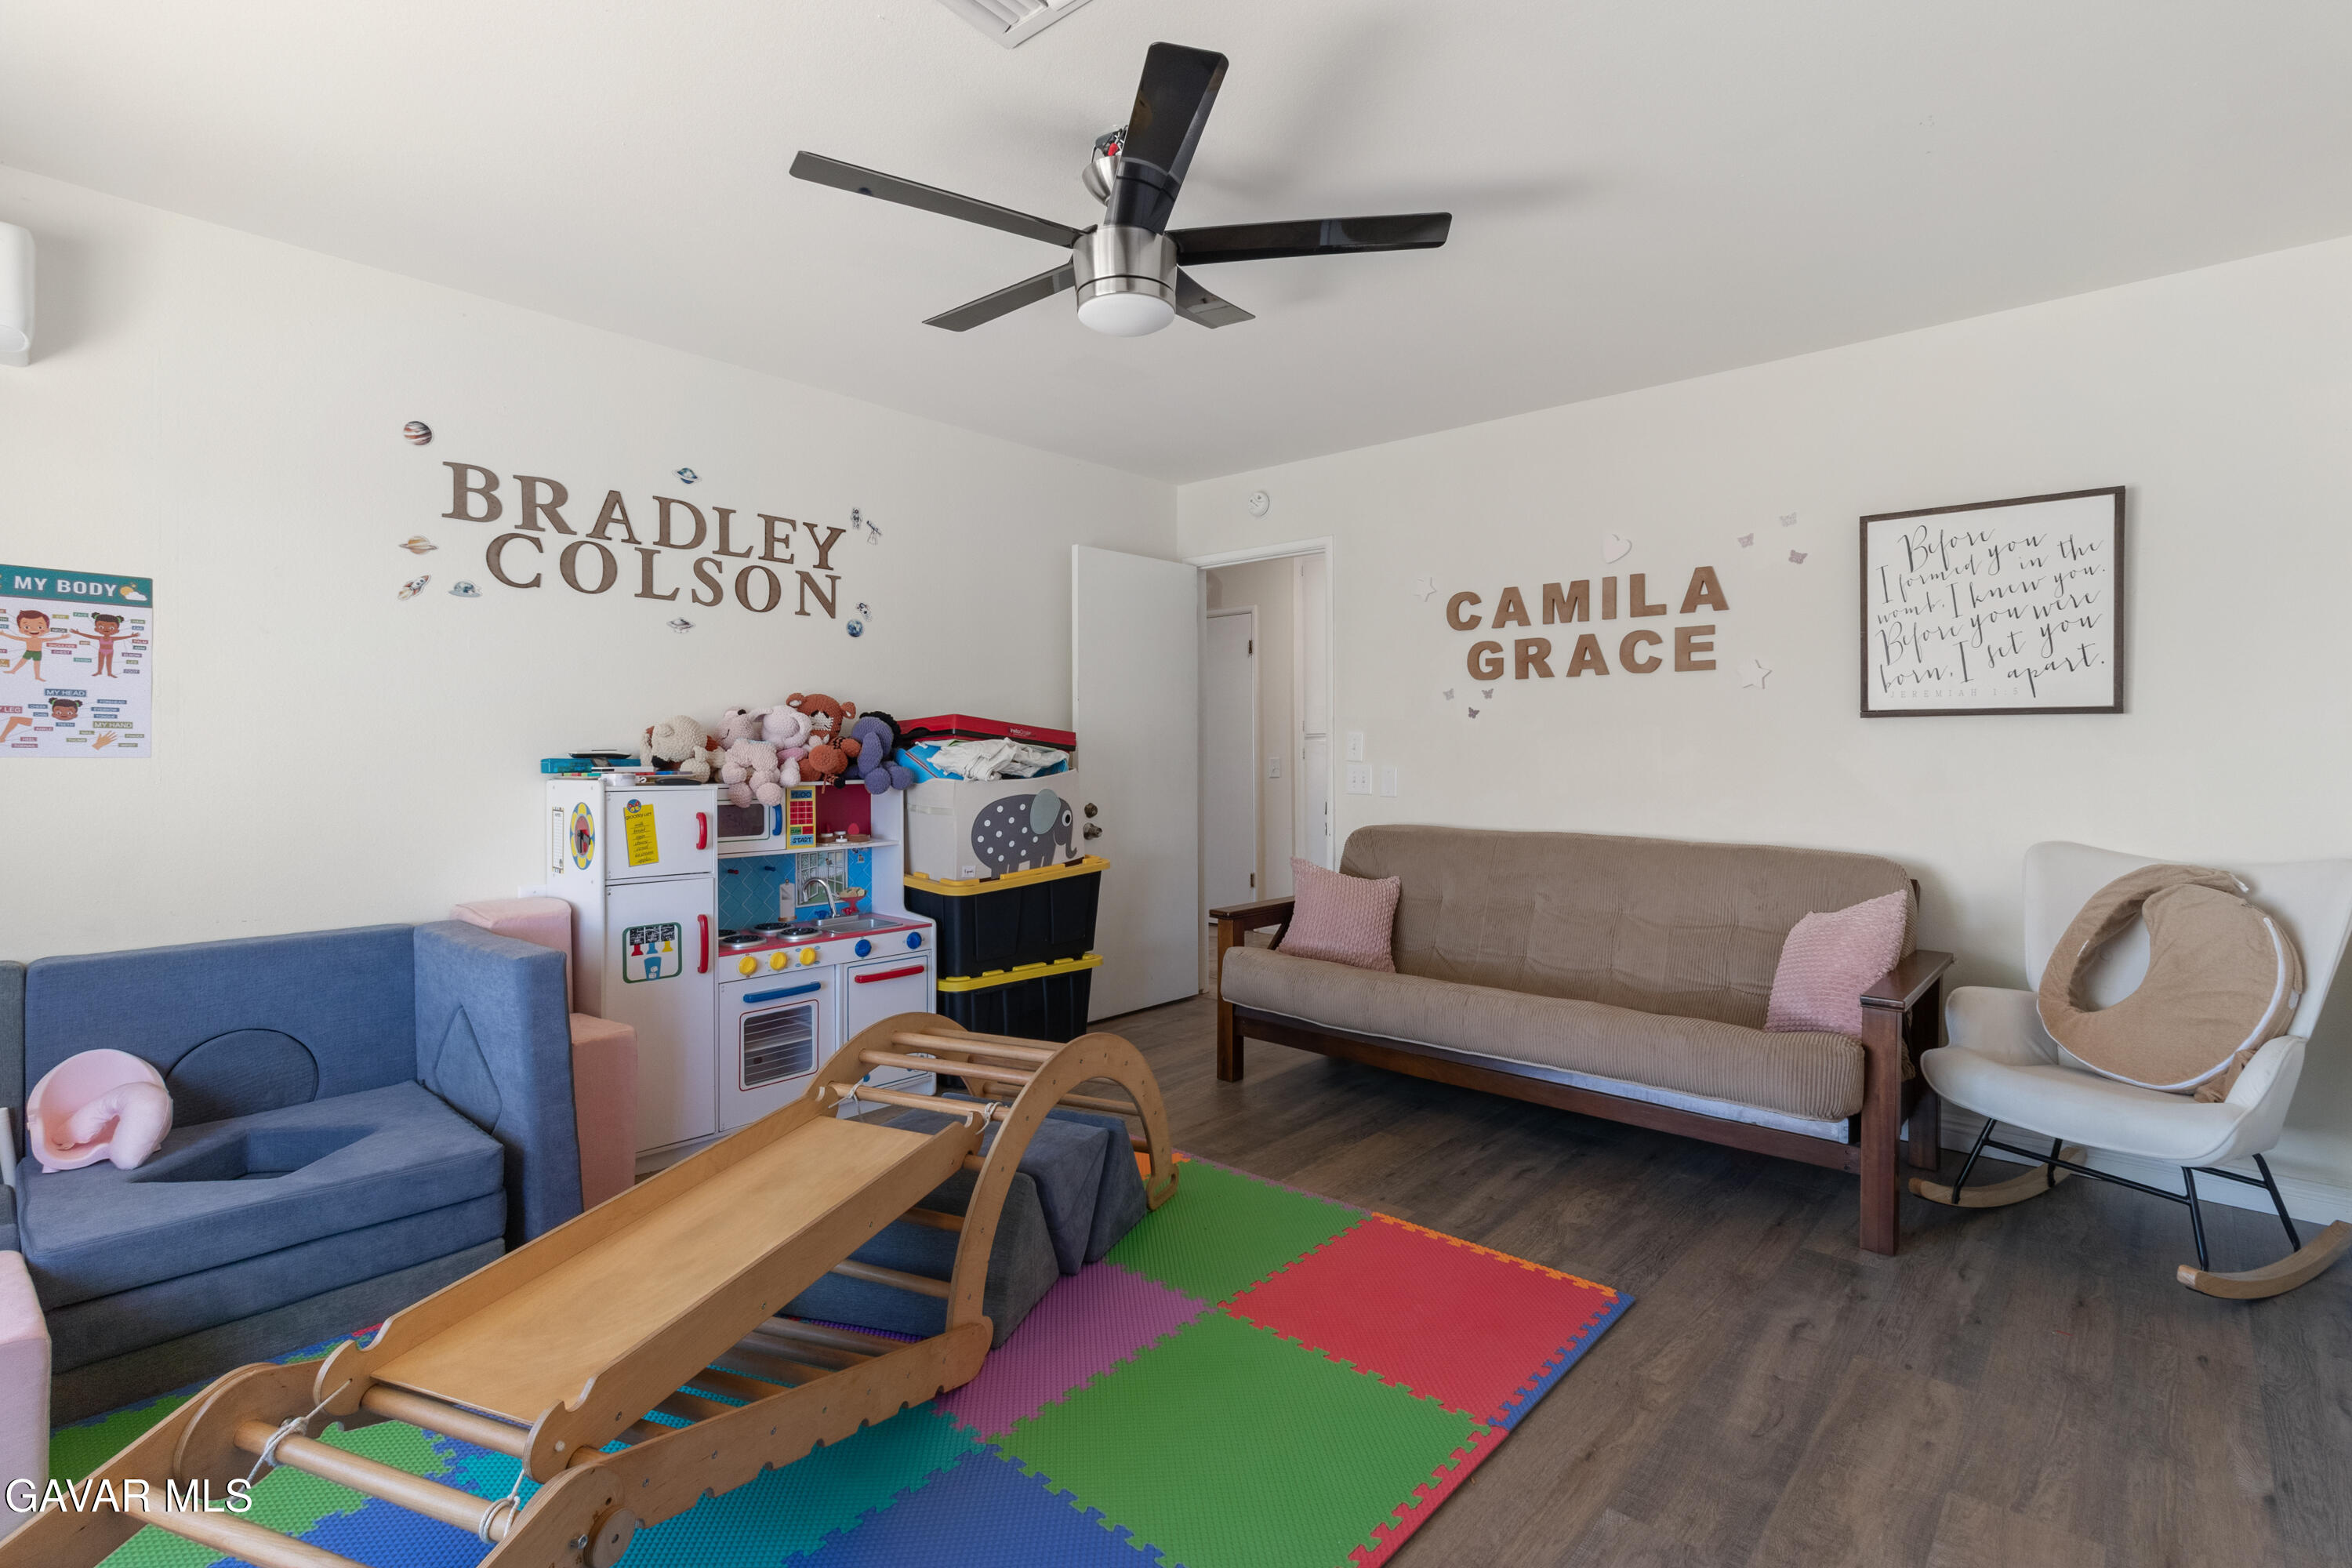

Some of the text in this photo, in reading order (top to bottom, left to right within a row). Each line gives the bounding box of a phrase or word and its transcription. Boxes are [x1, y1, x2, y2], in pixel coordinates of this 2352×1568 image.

[441, 461, 846, 571] BRADLEY
[485, 532, 841, 619] COLSON
[1876, 534, 2104, 604] I formed in the
[1897, 524, 2048, 576] Before you
[14, 575, 117, 597] MY BODY
[1446, 565, 1730, 631] CAMILA
[1946, 582, 1963, 619] I
[1970, 575, 2045, 608] knew
[1467, 625, 1717, 681] GRACE
[1875, 590, 2101, 666] Before you were
[1952, 640, 1974, 684] I
[1987, 631, 2026, 668] set
[2040, 613, 2103, 659] you
[1890, 689, 1976, 699] JEREMIAH
[2007, 643, 2105, 699] apart.
